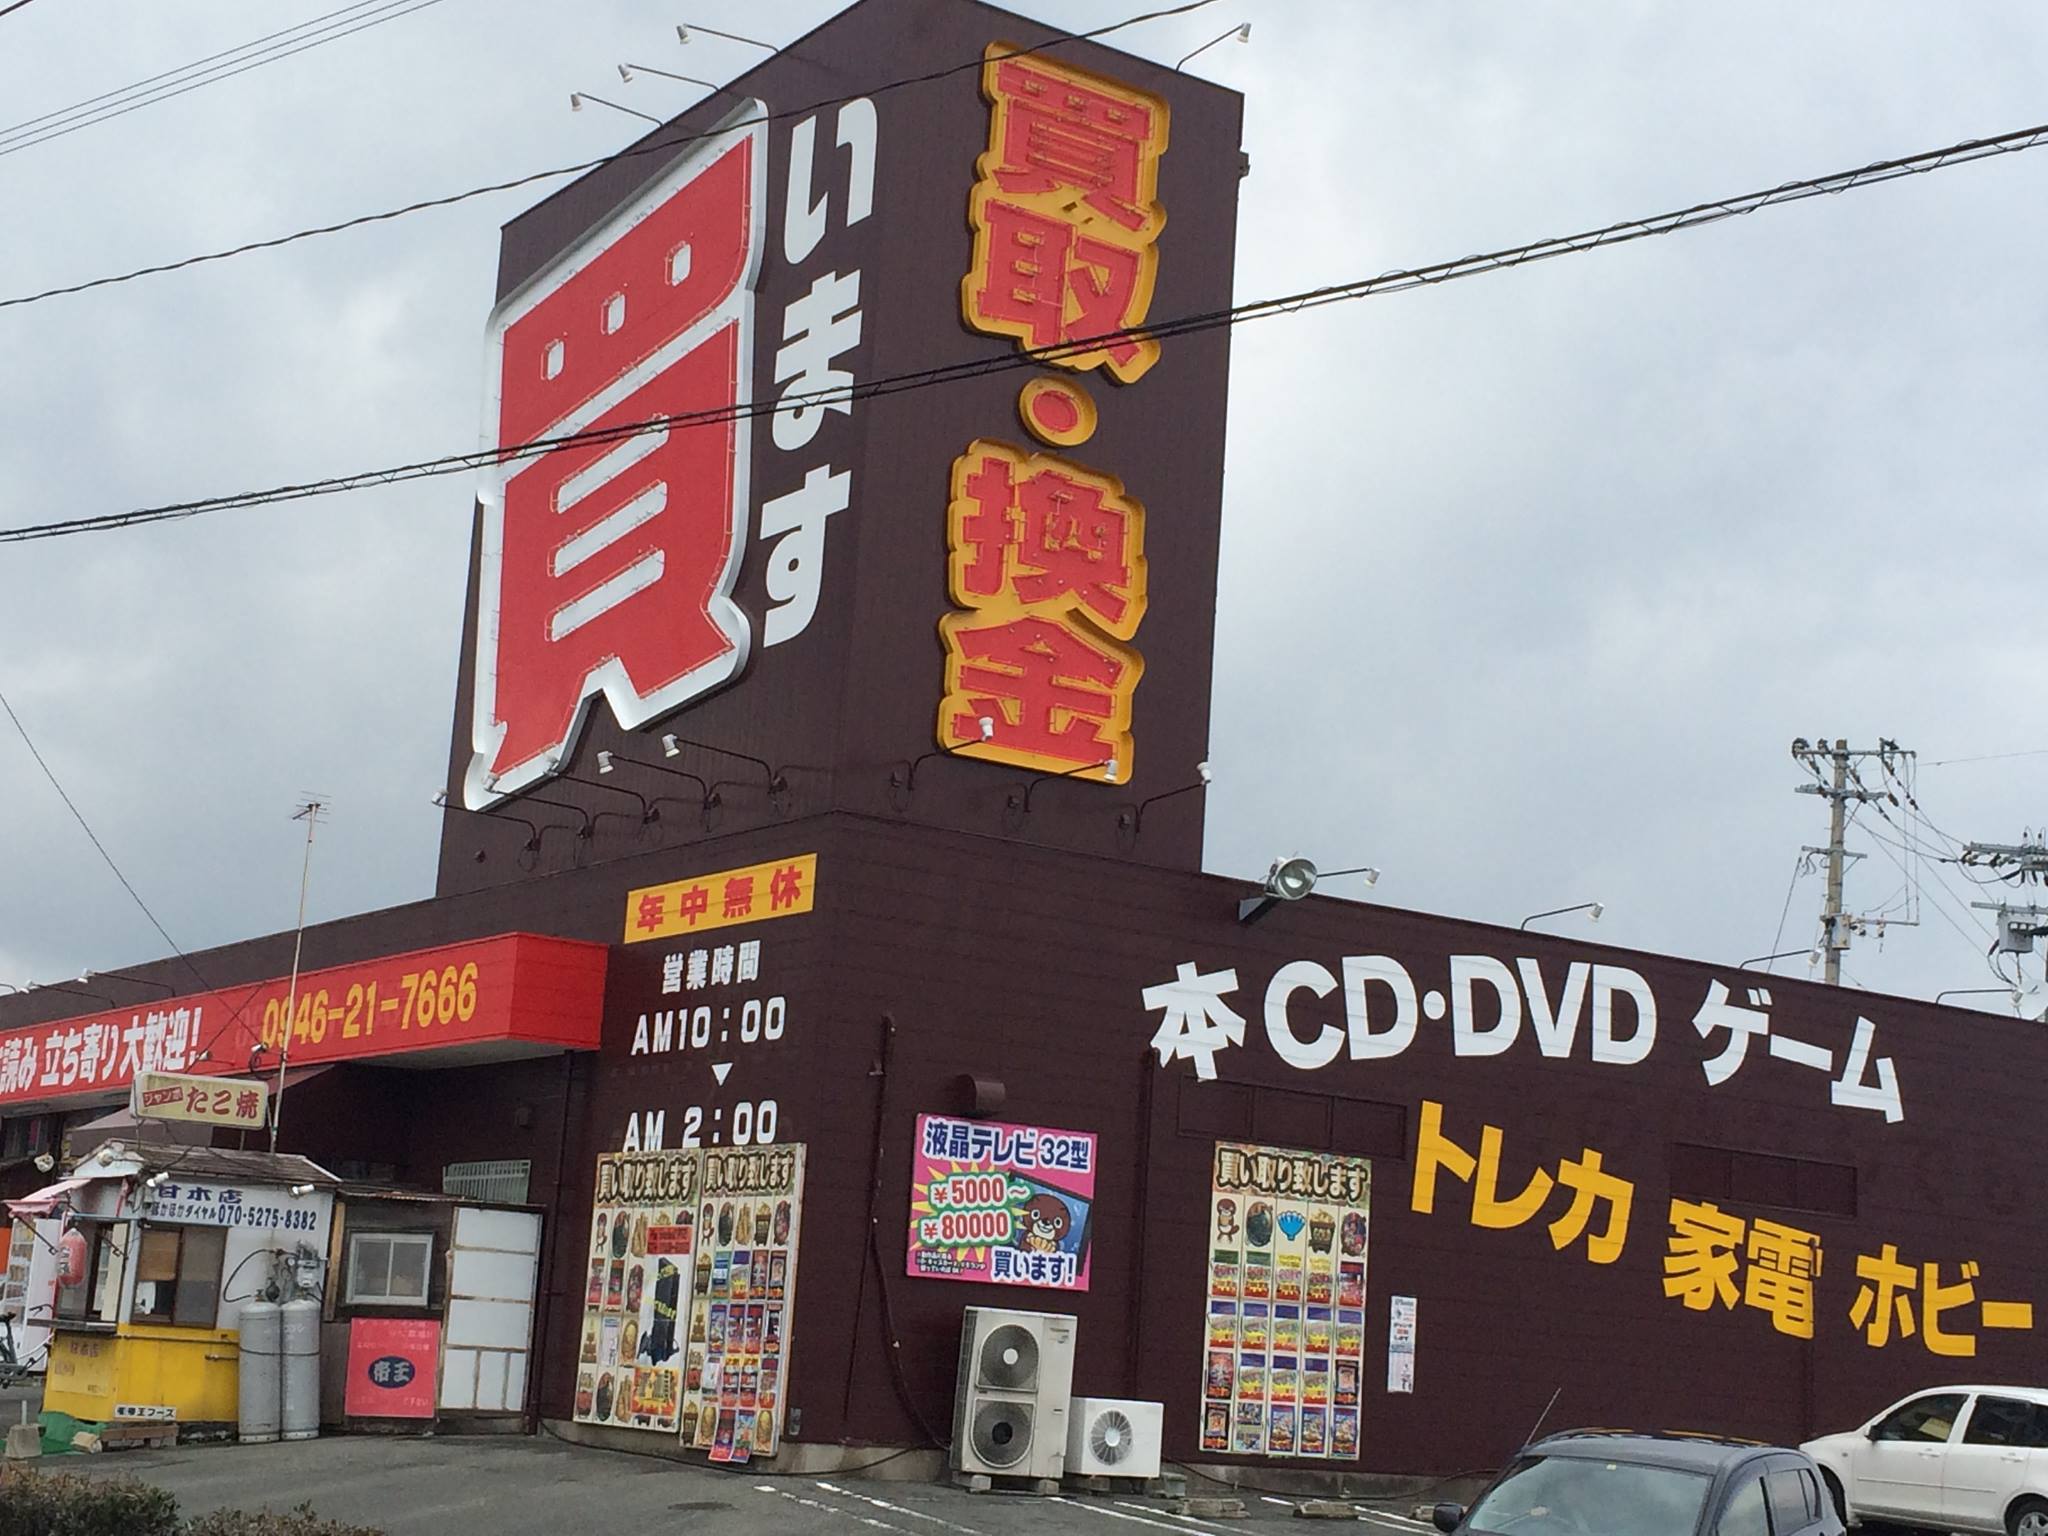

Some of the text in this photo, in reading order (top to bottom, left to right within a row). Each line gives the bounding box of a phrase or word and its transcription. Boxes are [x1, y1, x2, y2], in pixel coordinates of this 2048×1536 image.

[759, 97, 877, 647] います
[464, 97, 768, 811] 買
[636, 864, 802, 932] 年中無休
[261, 961, 479, 1049] 0946-21-7666
[661, 939, 761, 995] 営業時間
[1142, 962, 1247, 1081] 本
[1692, 977, 1905, 1123] ゲーム
[186, 1086, 259, 1119] たこ焼
[623, 1110, 665, 1153] AM
[1216, 1149, 1369, 1202] 買い取り致します
[1411, 1100, 1636, 1264] トレカ
[993, 1250, 1077, 1284] 買います!
[1662, 1198, 2034, 1357] 家電 ホビー
